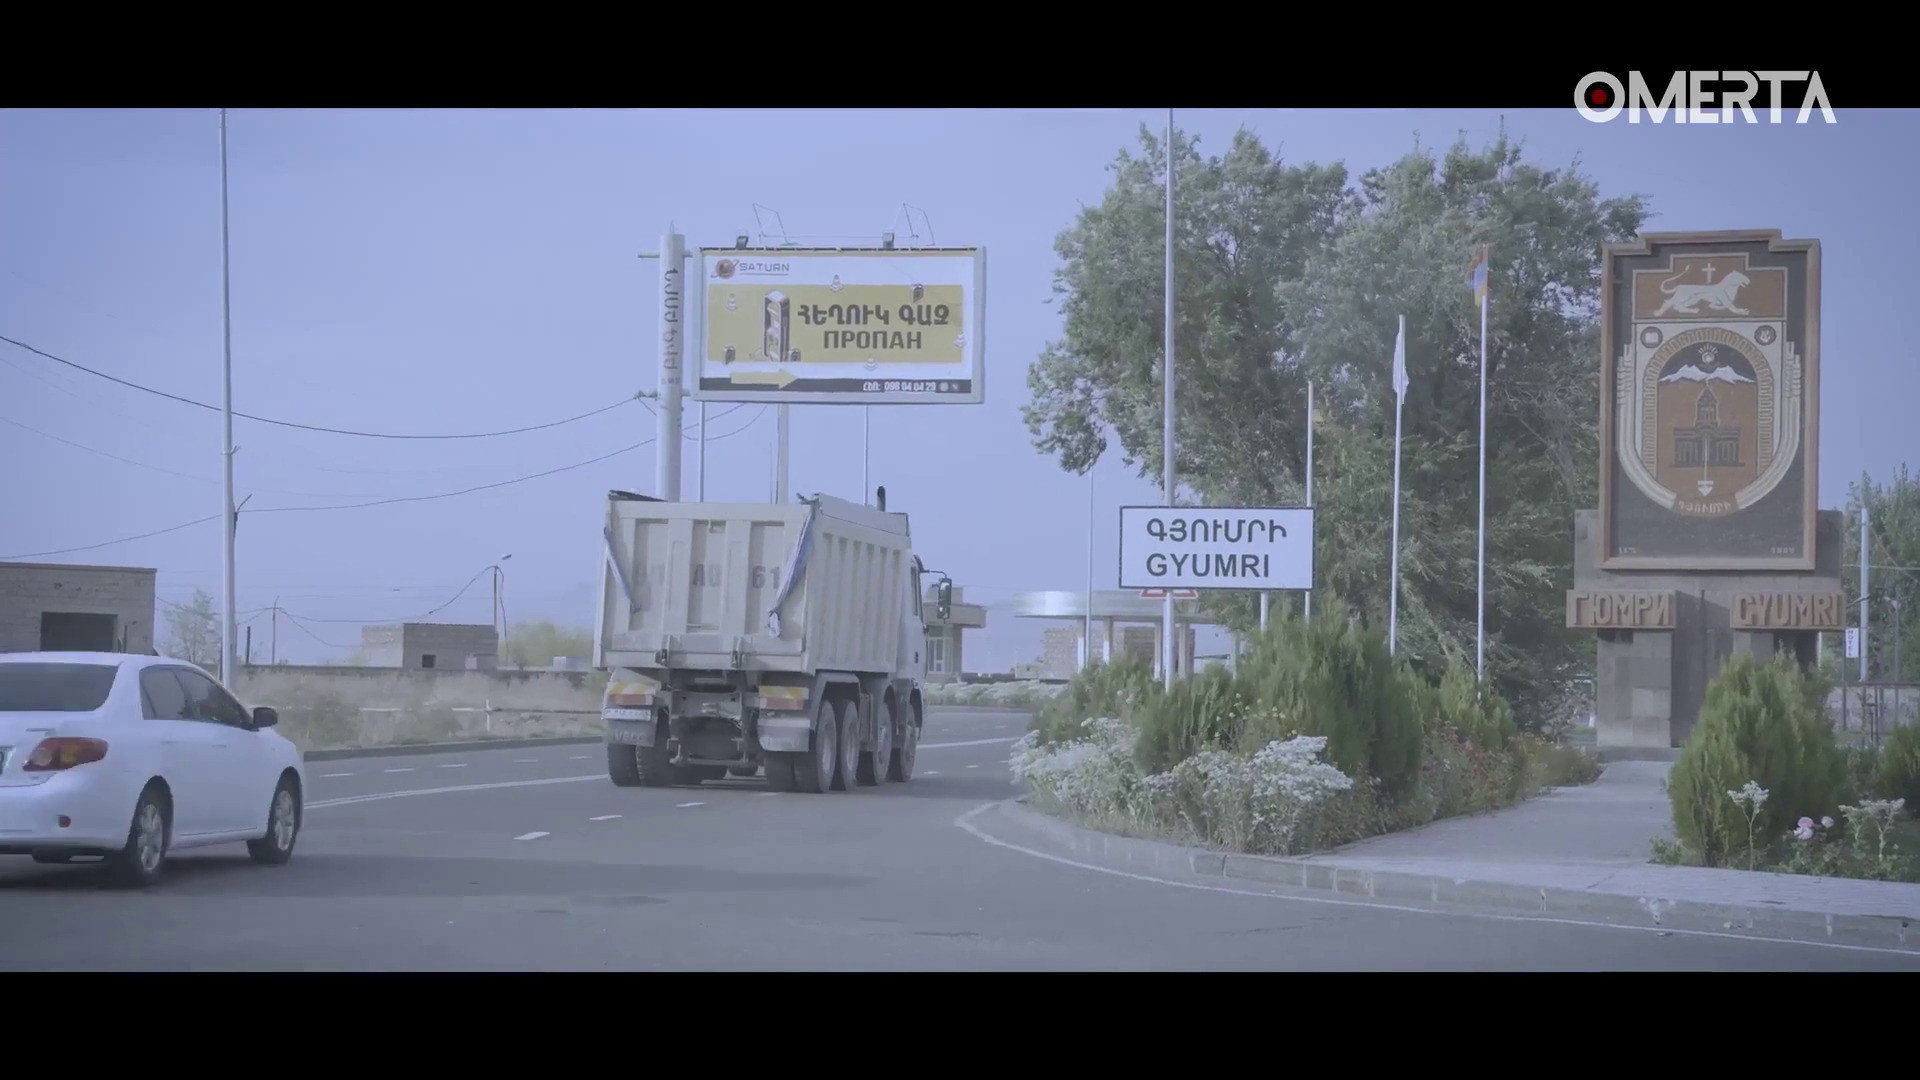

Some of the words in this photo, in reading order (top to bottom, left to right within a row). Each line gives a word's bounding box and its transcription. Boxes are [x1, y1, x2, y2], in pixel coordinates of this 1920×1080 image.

[739, 262, 790, 272] SATURN
[798, 303, 890, 326] ՀԵՂՈՒԿ
[823, 330, 922, 350] ПРОПАН
[1146, 518, 1287, 543] ԳՅՈՒՄՐԻ
[1146, 553, 1269, 578] GYUMRI
[1575, 592, 1670, 627] ГЮМРИ
[1738, 592, 1841, 627] GYUMRI
